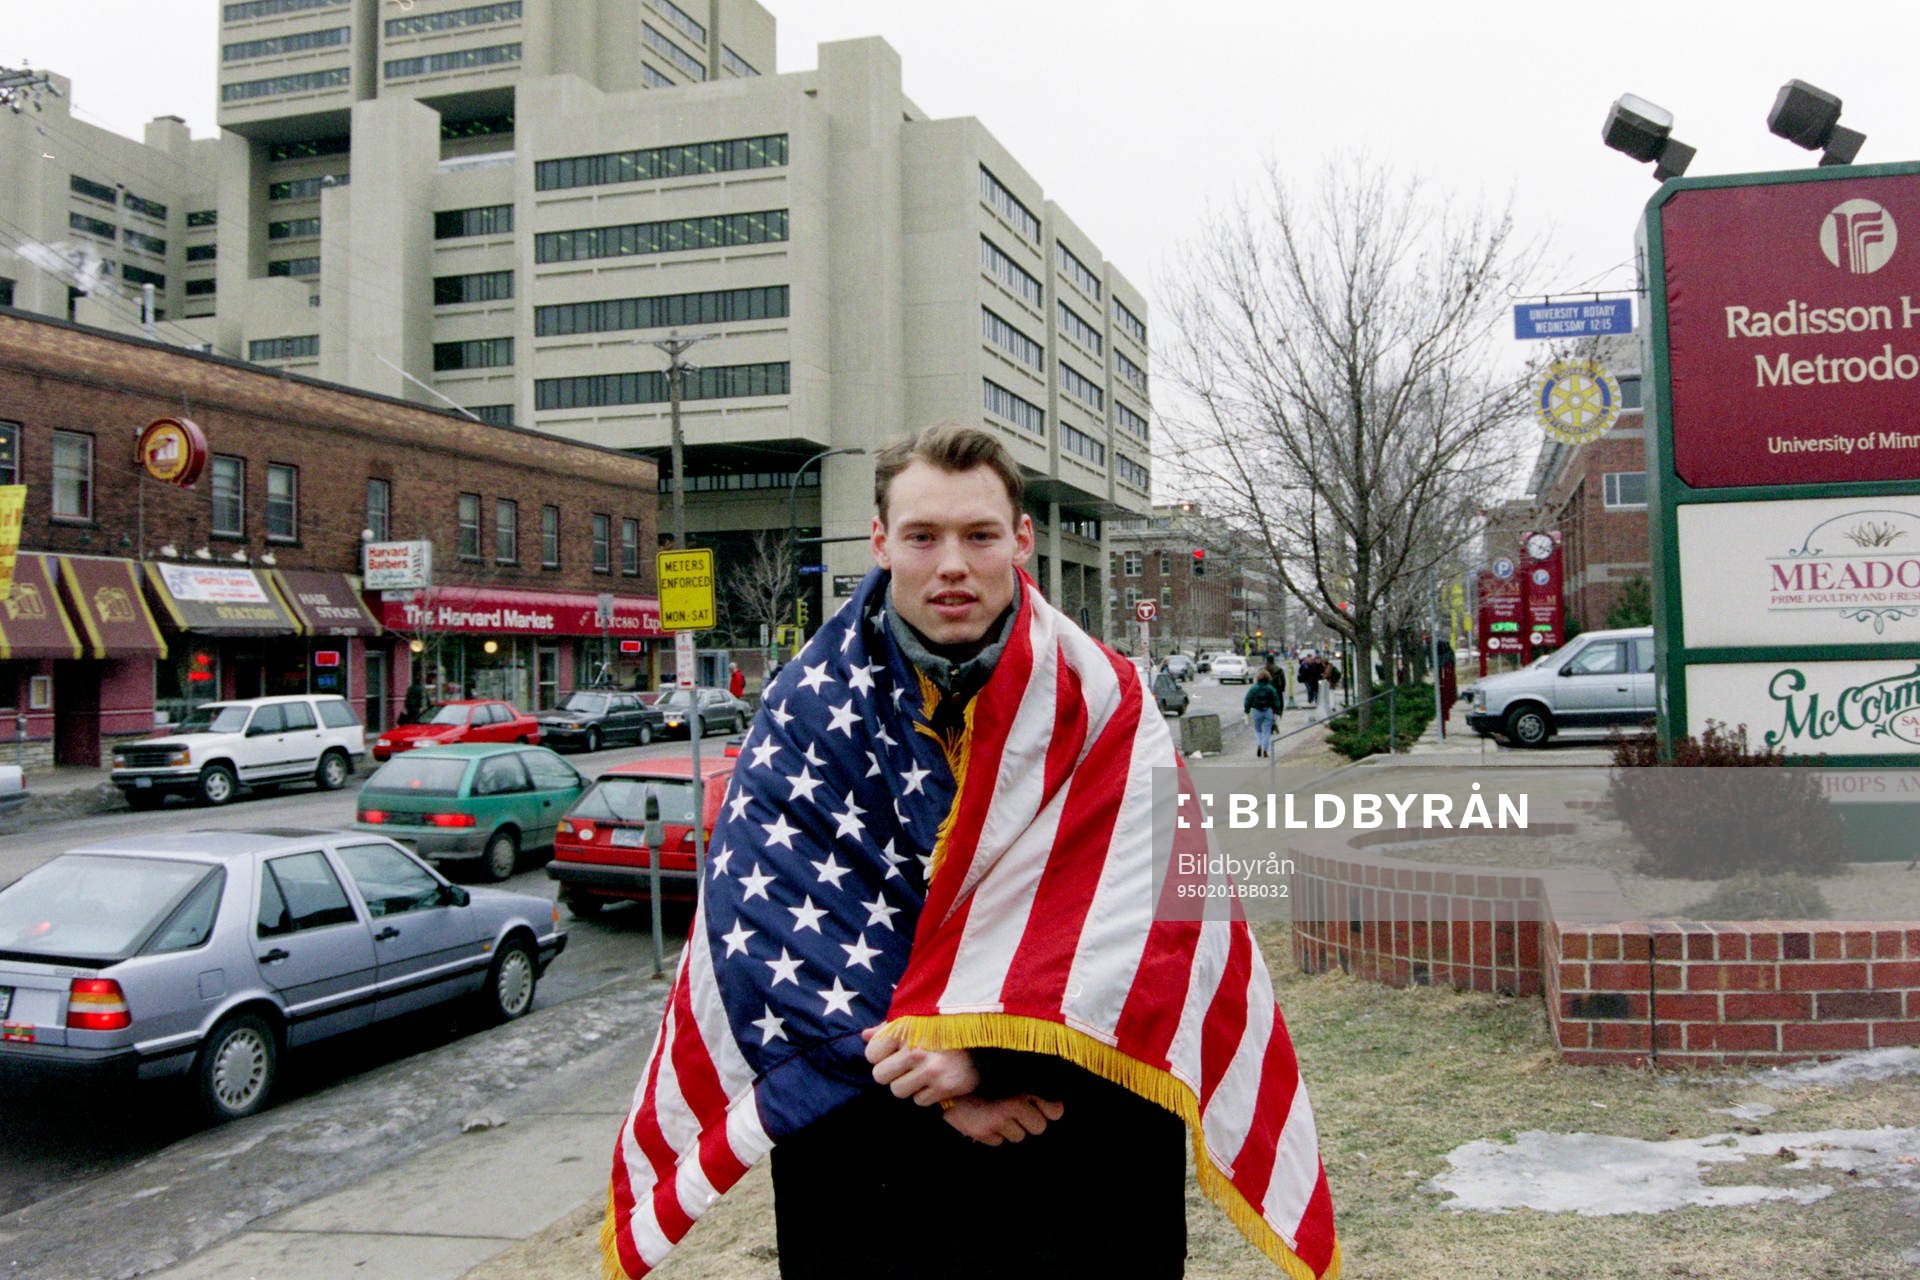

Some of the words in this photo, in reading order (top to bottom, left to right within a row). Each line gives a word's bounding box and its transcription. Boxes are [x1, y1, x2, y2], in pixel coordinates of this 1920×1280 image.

[1529, 306, 1579, 321] UNIVERSITY
[1583, 304, 1616, 318] ROTARY
[1725, 299, 1893, 338] Radisson
[1535, 319, 1586, 333] WEDNESDAY
[1754, 343, 1919, 387] Metrodo
[1768, 434, 1854, 455] University
[1857, 432, 1876, 450] of
[664, 560, 705, 572] METERS
[661, 576, 712, 590] ENFORCED
[1770, 559, 1920, 592] MEADO
[1771, 595, 1804, 605] PRIME
[1807, 593, 1859, 603] POULTRY
[1861, 592, 1887, 602] AND
[403, 604, 435, 626] The
[438, 606, 500, 627] Harvard
[503, 609, 554, 630] Market
[1822, 775, 1887, 793] HOPS
